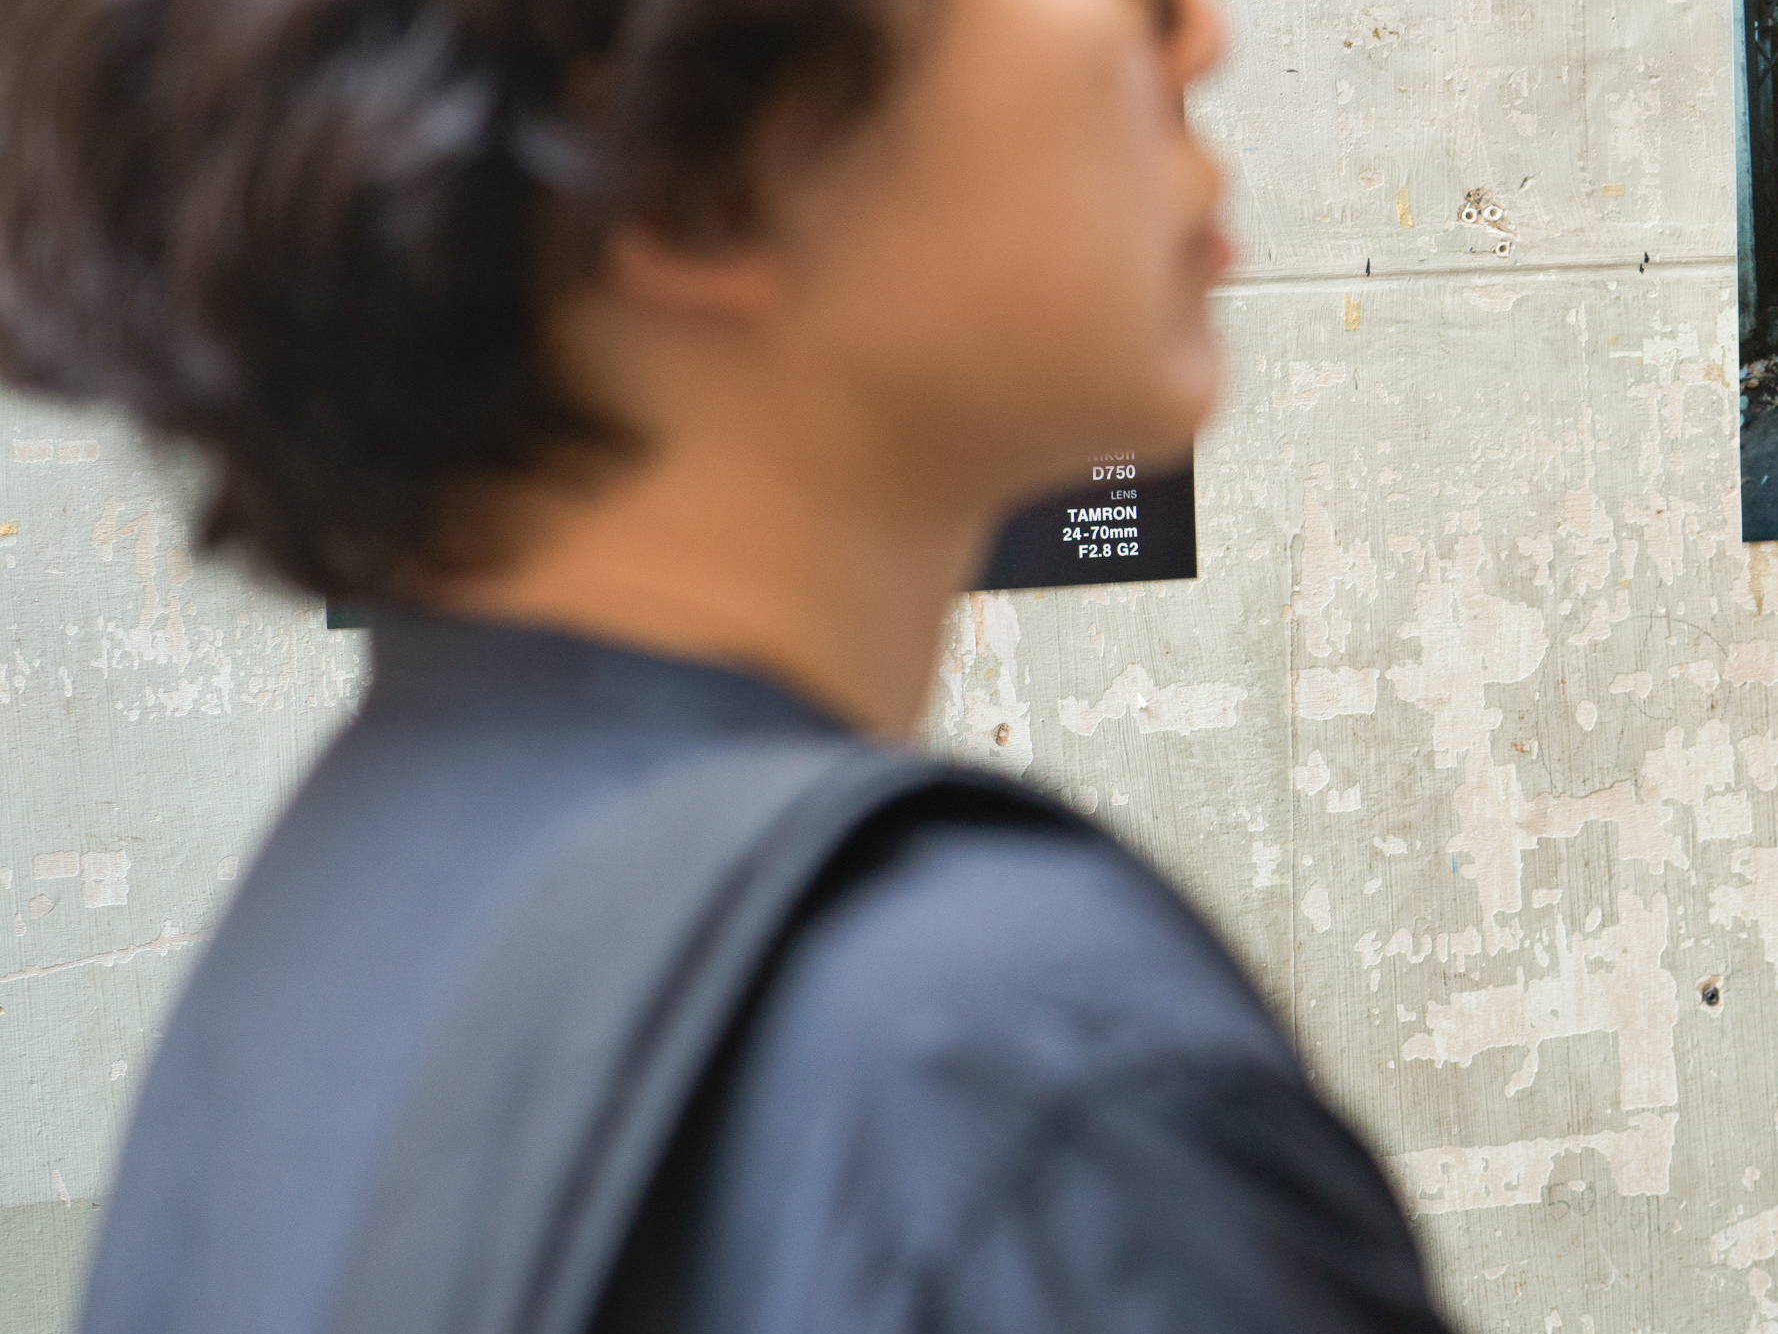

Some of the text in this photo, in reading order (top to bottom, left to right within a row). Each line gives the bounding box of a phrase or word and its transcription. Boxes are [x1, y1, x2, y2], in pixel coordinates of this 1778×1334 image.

[1092, 464, 1136, 481] D750
[1110, 489, 1138, 501] LENS
[1067, 506, 1137, 523] TAMRON
[1062, 526, 1139, 542] 24-70mm
[1079, 542, 1139, 558] F2.8 G2
